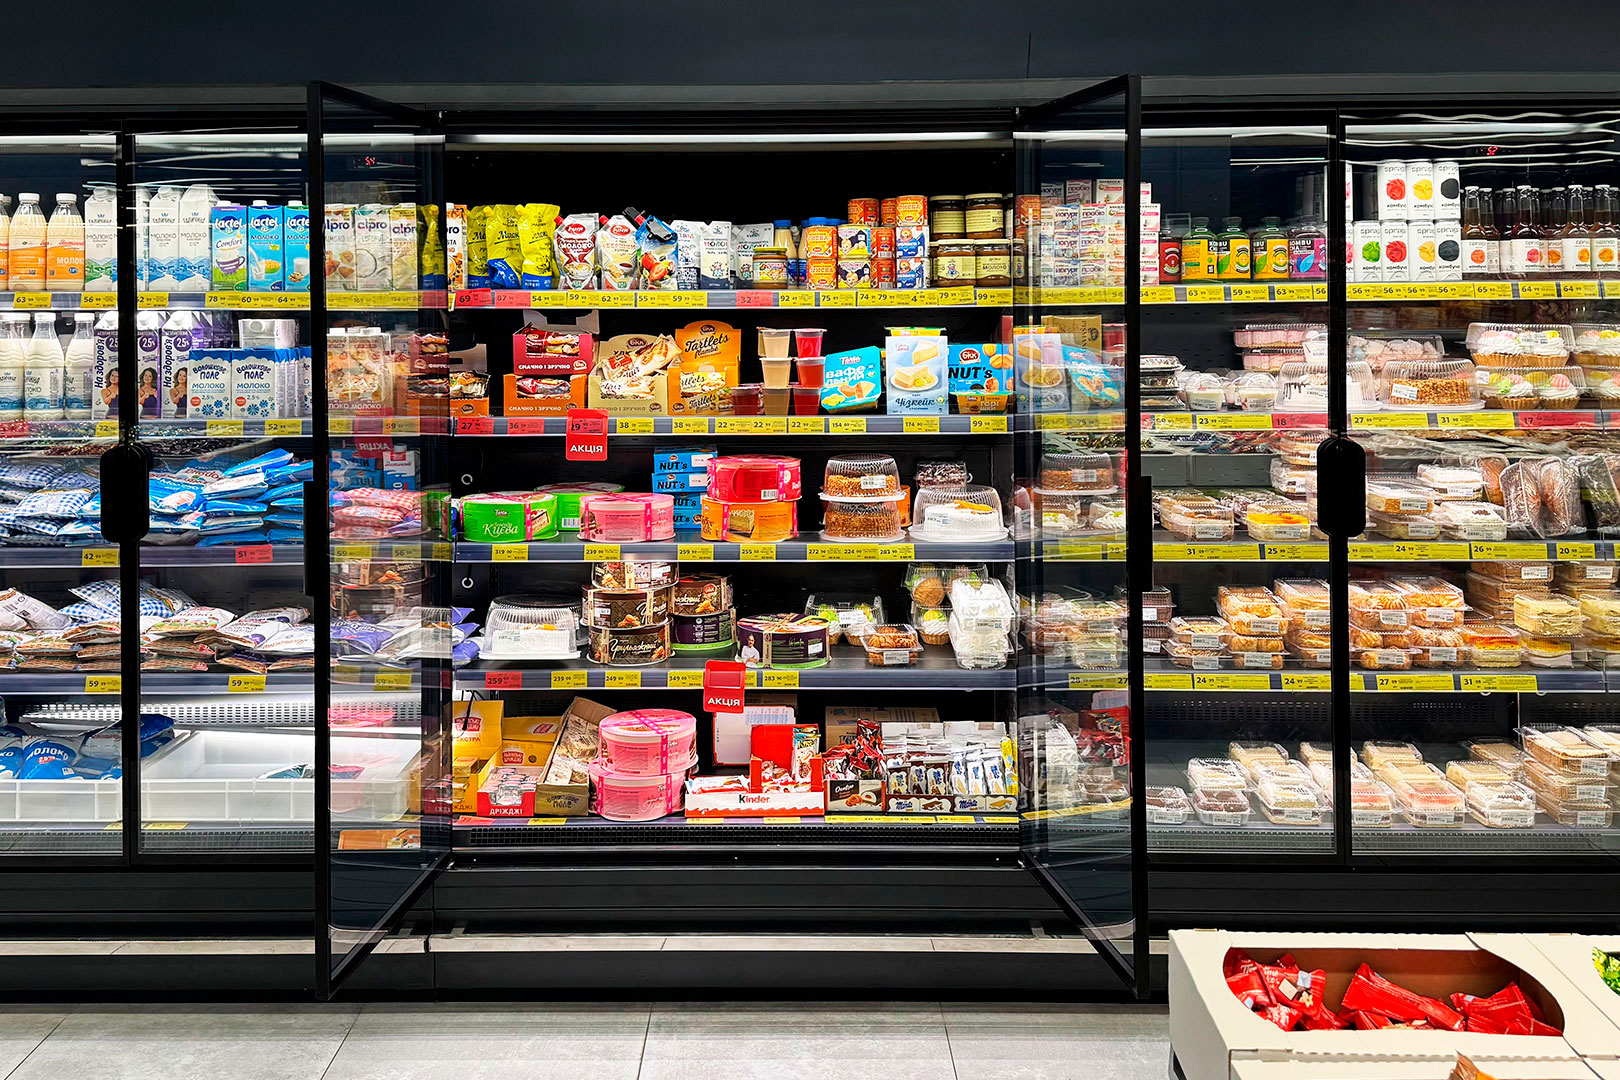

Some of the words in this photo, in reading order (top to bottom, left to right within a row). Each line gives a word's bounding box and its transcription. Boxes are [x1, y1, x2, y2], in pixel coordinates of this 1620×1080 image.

[214, 217, 244, 230] lactel
[250, 217, 279, 230] lactel
[324, 218, 350, 232] lpro
[215, 238, 244, 250] Comfort
[685, 334, 728, 352] Tartlets
[570, 444, 603, 453] АКЦІЯ
[659, 462, 687, 470] NUT's
[657, 481, 685, 490] NUT's
[483, 524, 518, 538] Києва
[708, 698, 740, 707] АКЦІЯ
[738, 795, 770, 804] Kinder
